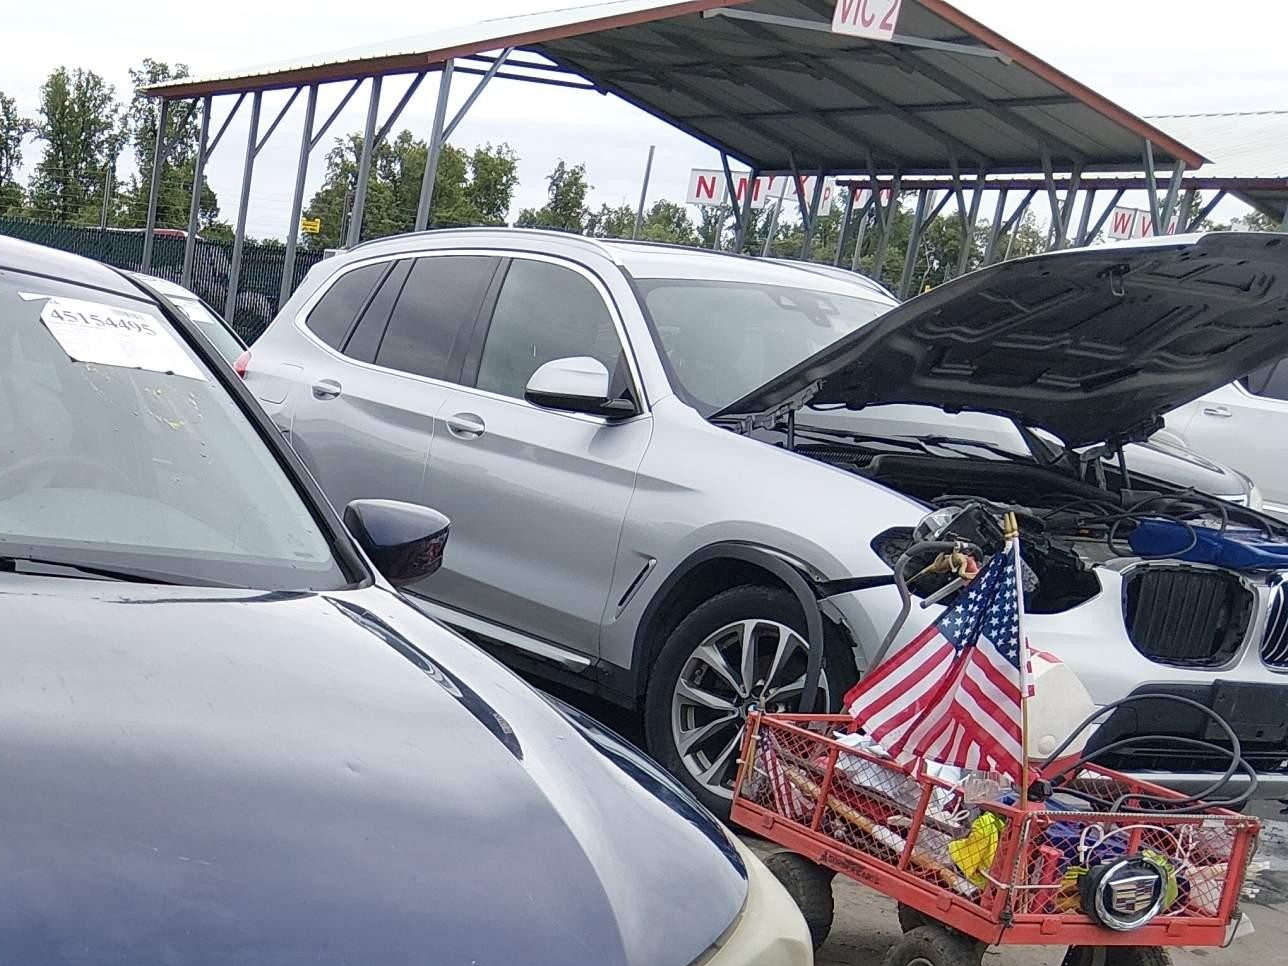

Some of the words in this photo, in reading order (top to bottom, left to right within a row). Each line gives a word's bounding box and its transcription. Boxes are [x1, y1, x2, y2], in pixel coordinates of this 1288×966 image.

[840, 0, 876, 28] VIC
[879, 0, 900, 32] 2
[695, 175, 717, 199] N
[1113, 211, 1132, 234] W
[51, 308, 157, 336] 45154495
